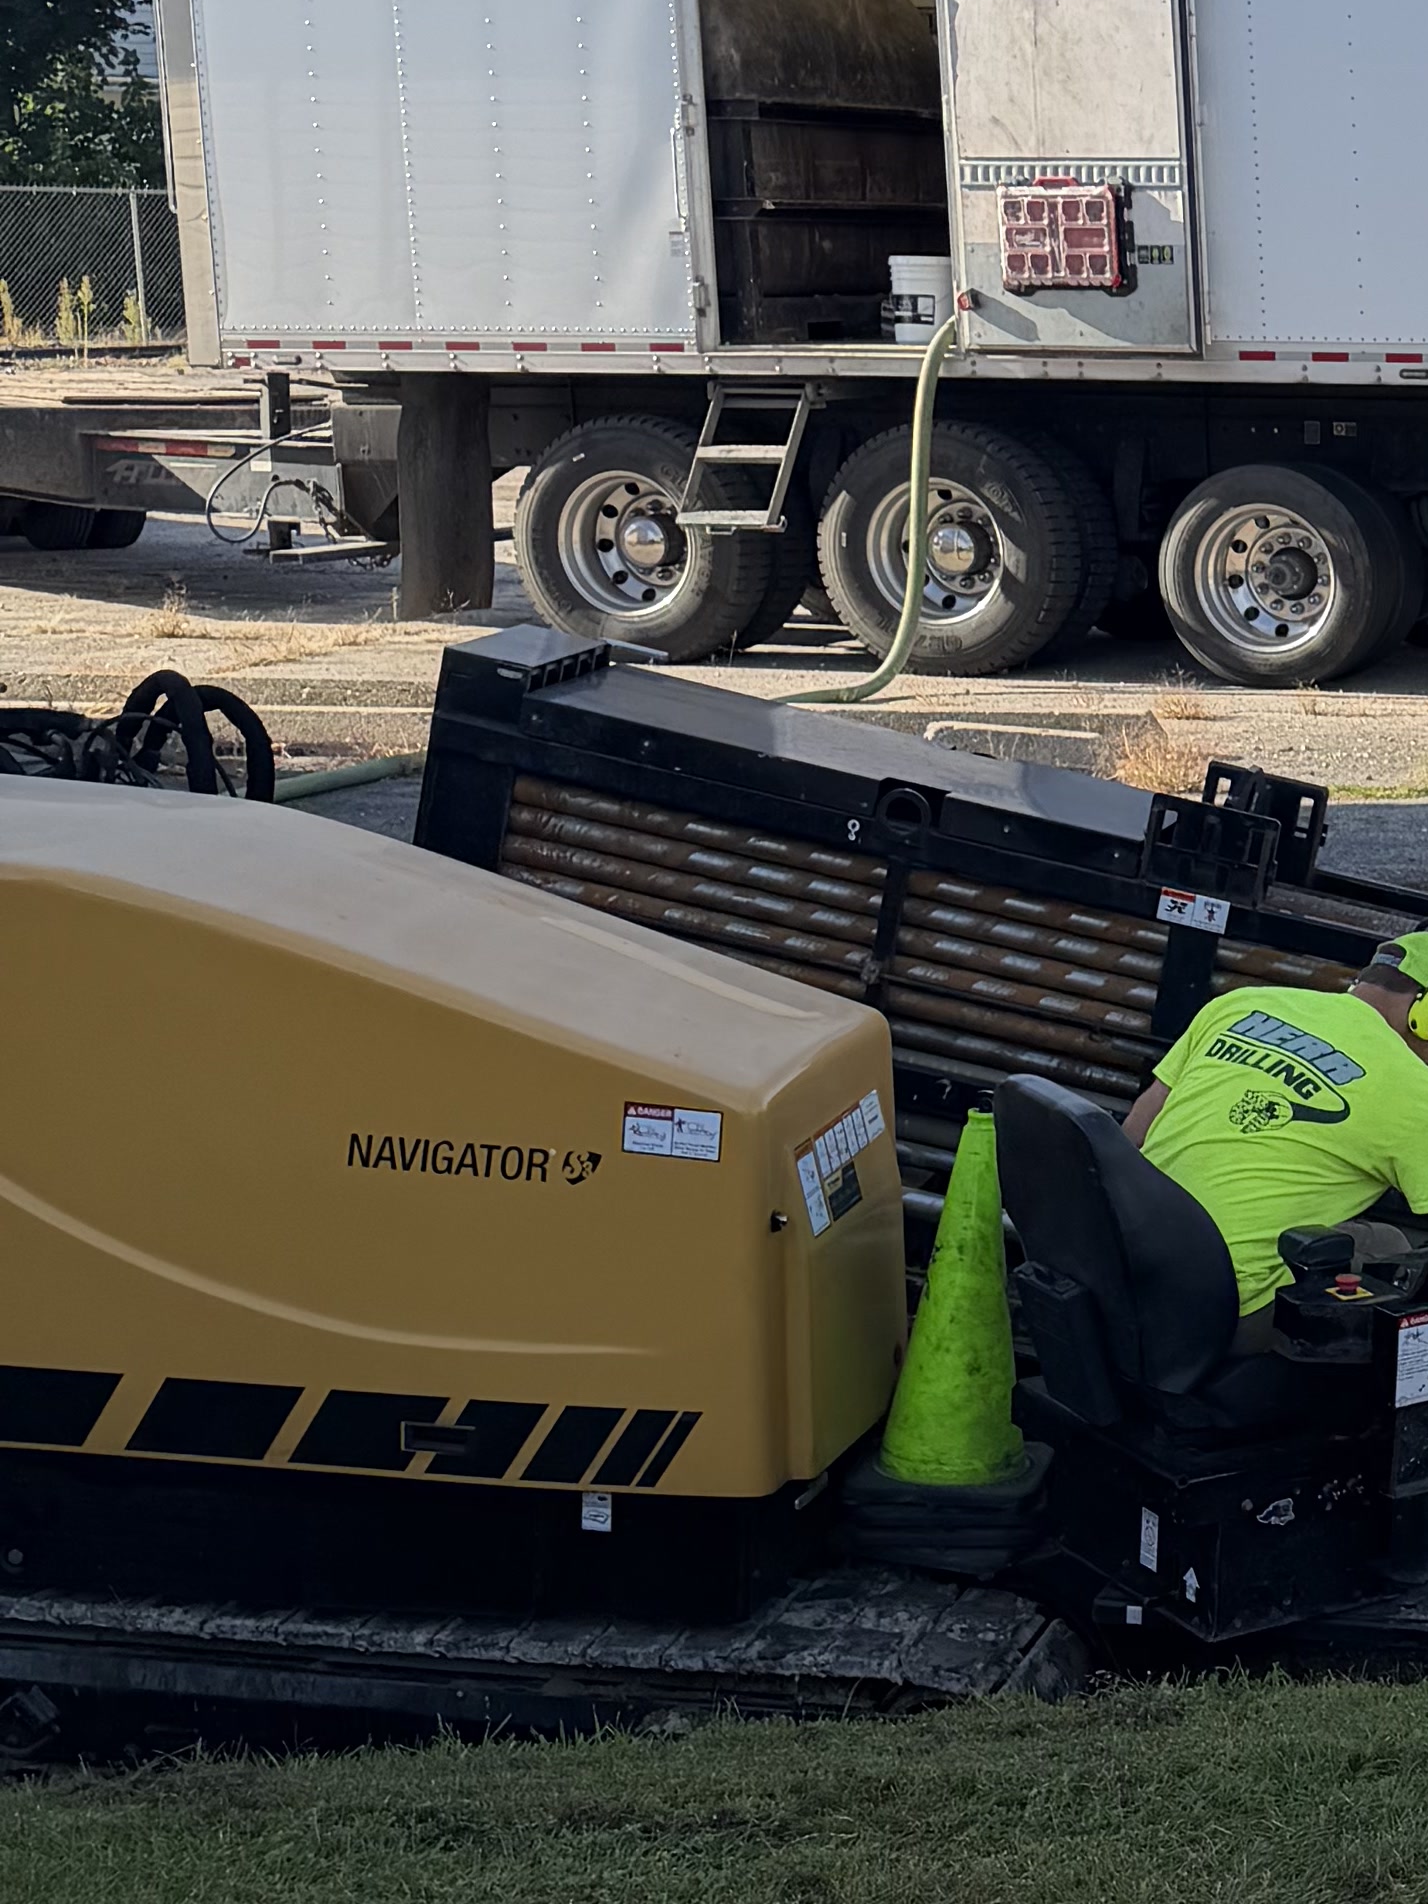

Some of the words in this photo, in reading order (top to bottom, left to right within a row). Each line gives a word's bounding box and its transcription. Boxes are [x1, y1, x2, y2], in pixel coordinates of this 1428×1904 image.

[1204, 1038, 1322, 1101] DRILLING
[1227, 1009, 1367, 1086] HERR
[347, 1133, 550, 1183] NAVIGATOR
